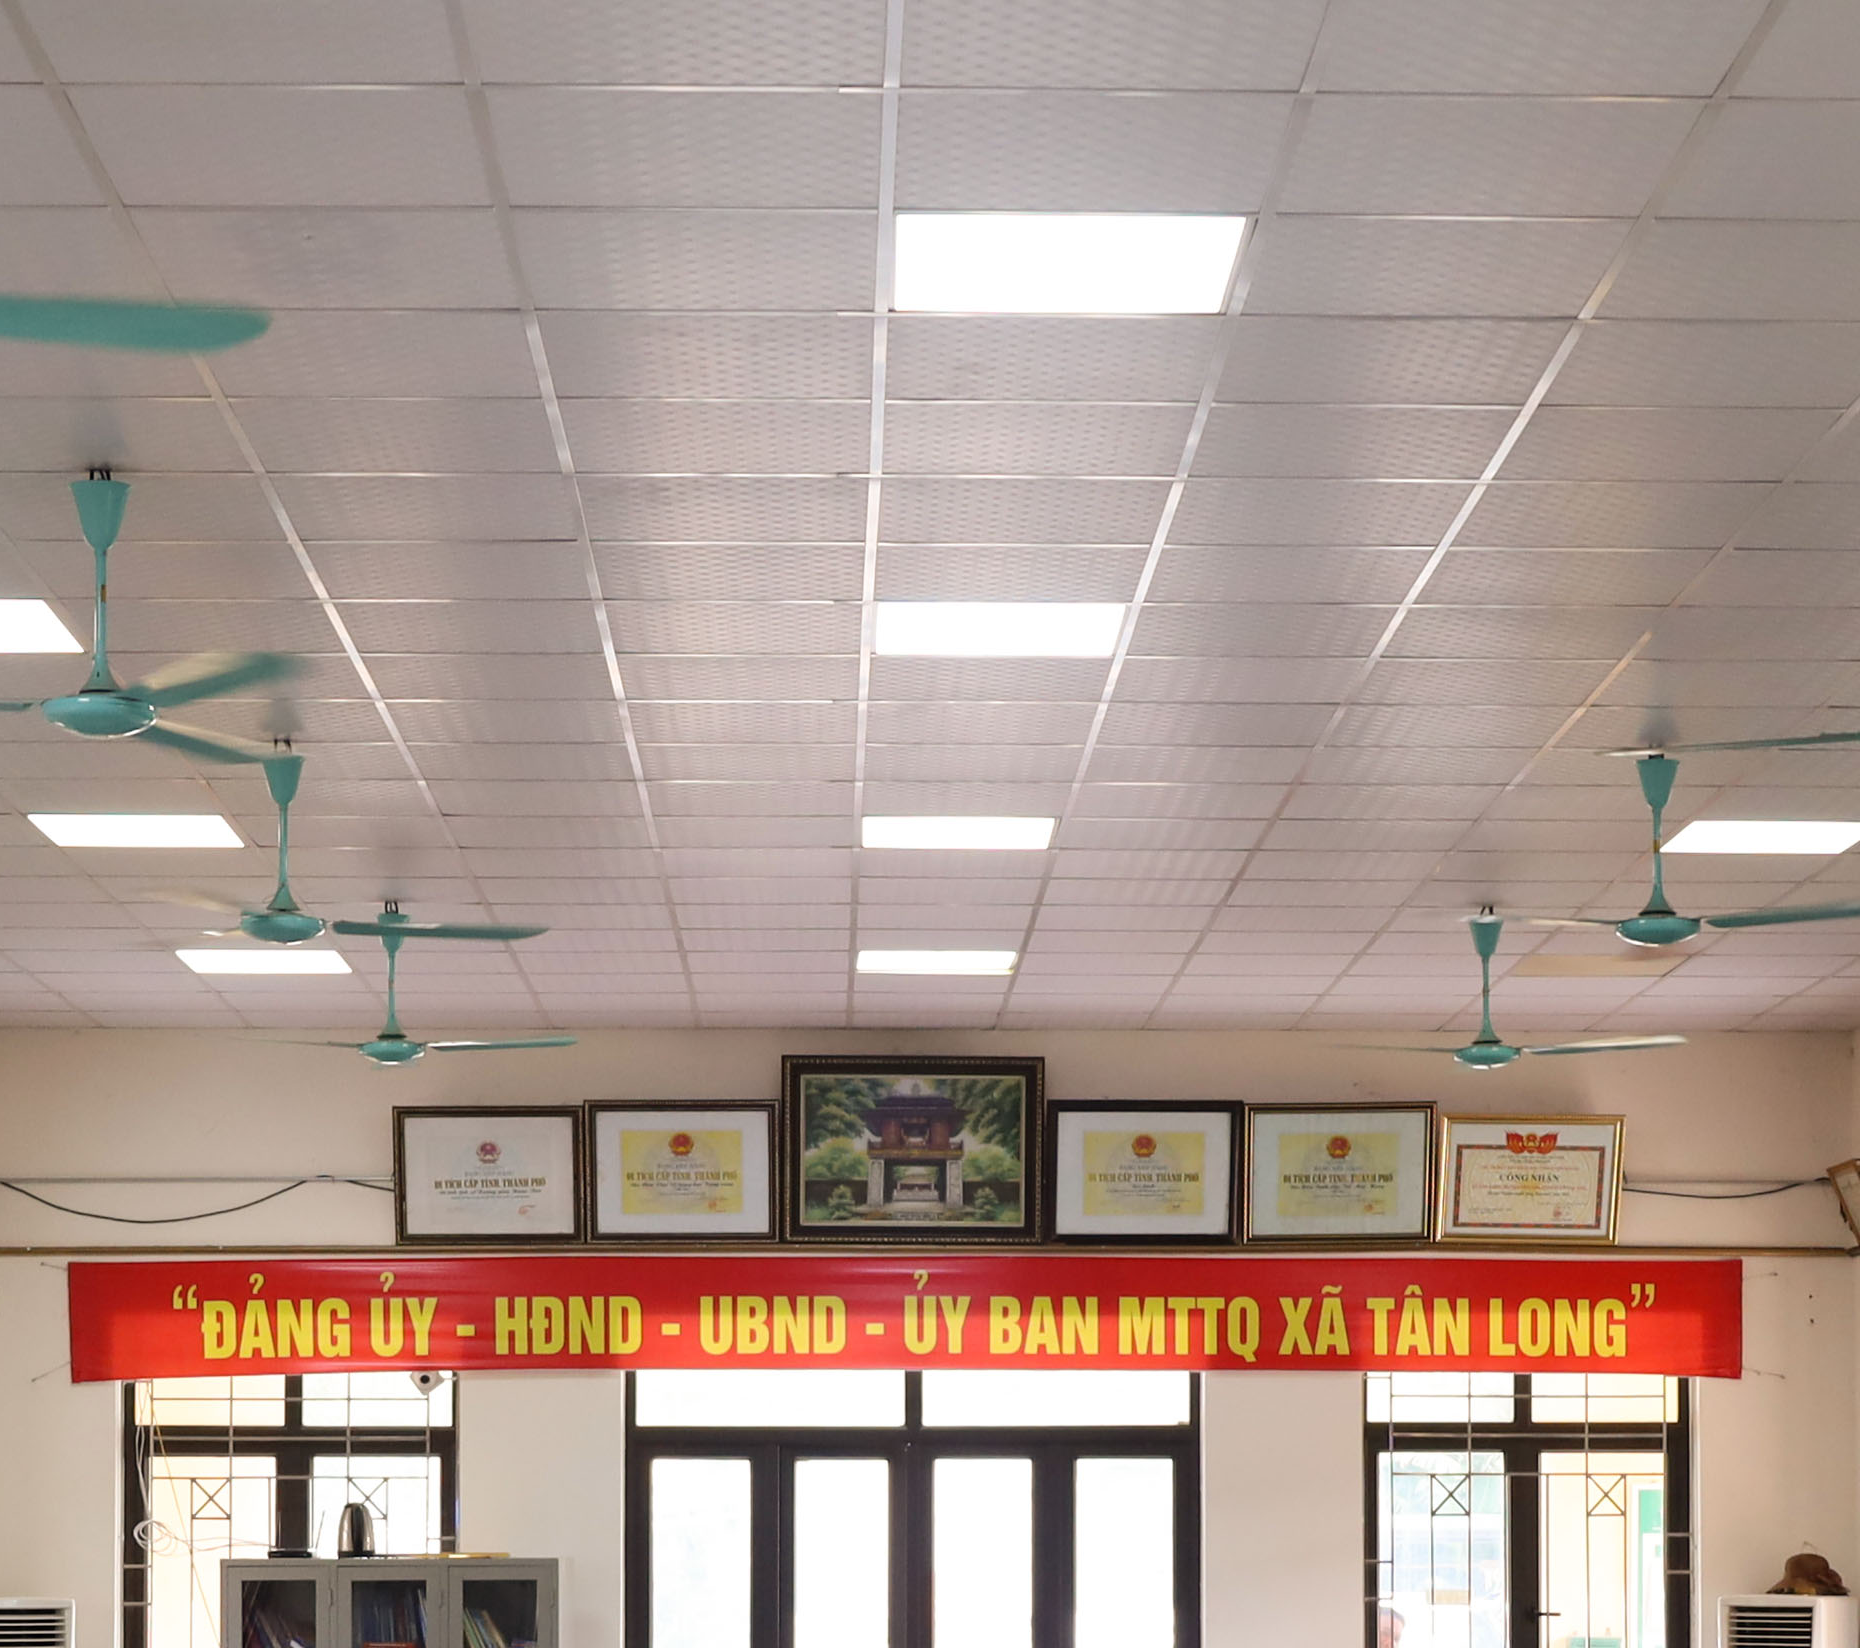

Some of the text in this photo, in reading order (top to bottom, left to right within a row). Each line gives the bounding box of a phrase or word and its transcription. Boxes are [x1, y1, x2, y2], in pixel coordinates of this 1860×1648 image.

[370, 1271, 438, 1356] ỦY
[495, 1296, 642, 1355] HĐND
[699, 1295, 847, 1355] UBND
[905, 1269, 970, 1356] ỦY
[989, 1297, 1100, 1356] BAN
[1119, 1296, 1260, 1363] MTTQ
[1278, 1286, 1352, 1356] XÃ
[1367, 1284, 1475, 1357] TÂN
